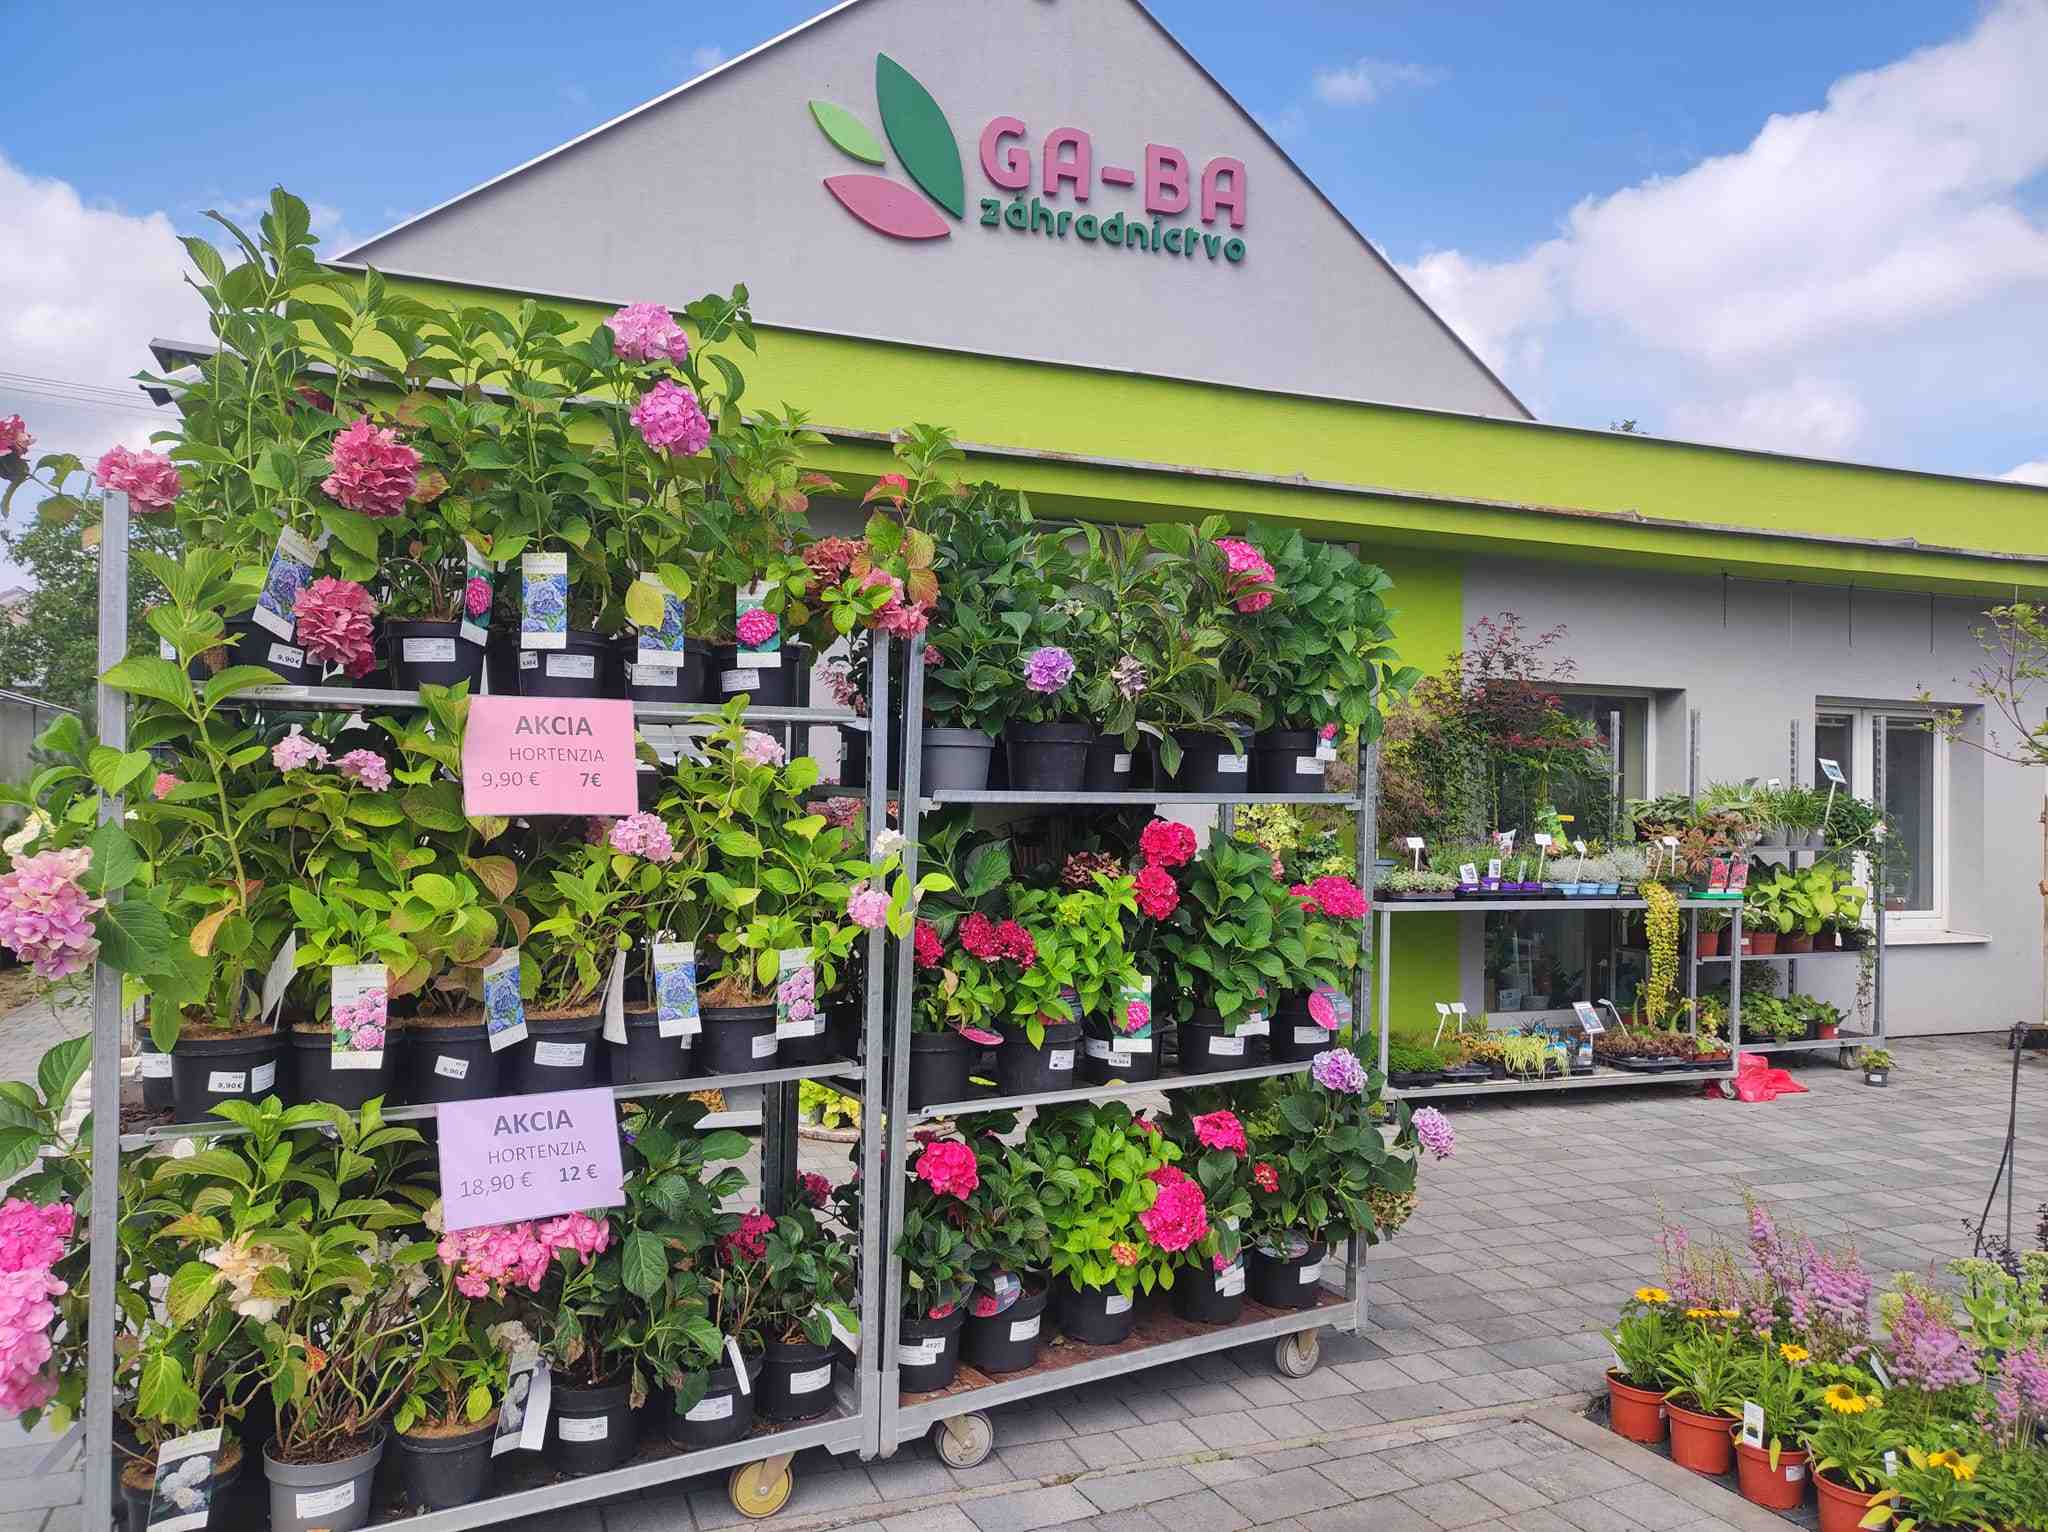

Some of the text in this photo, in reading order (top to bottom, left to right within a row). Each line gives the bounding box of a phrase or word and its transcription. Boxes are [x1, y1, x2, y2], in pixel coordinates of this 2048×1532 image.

[979, 115, 1246, 229] GA-BA
[980, 191, 1246, 264] záhradníctvo
[515, 715, 593, 737] AKCIA
[509, 747, 605, 762] HORTENZIA
[481, 771, 602, 788] 9,90 € 7€
[493, 1109, 574, 1137] AKCIA
[488, 1140, 588, 1165] HORTENZIA
[459, 1163, 599, 1199] 18,90 € 12 €
